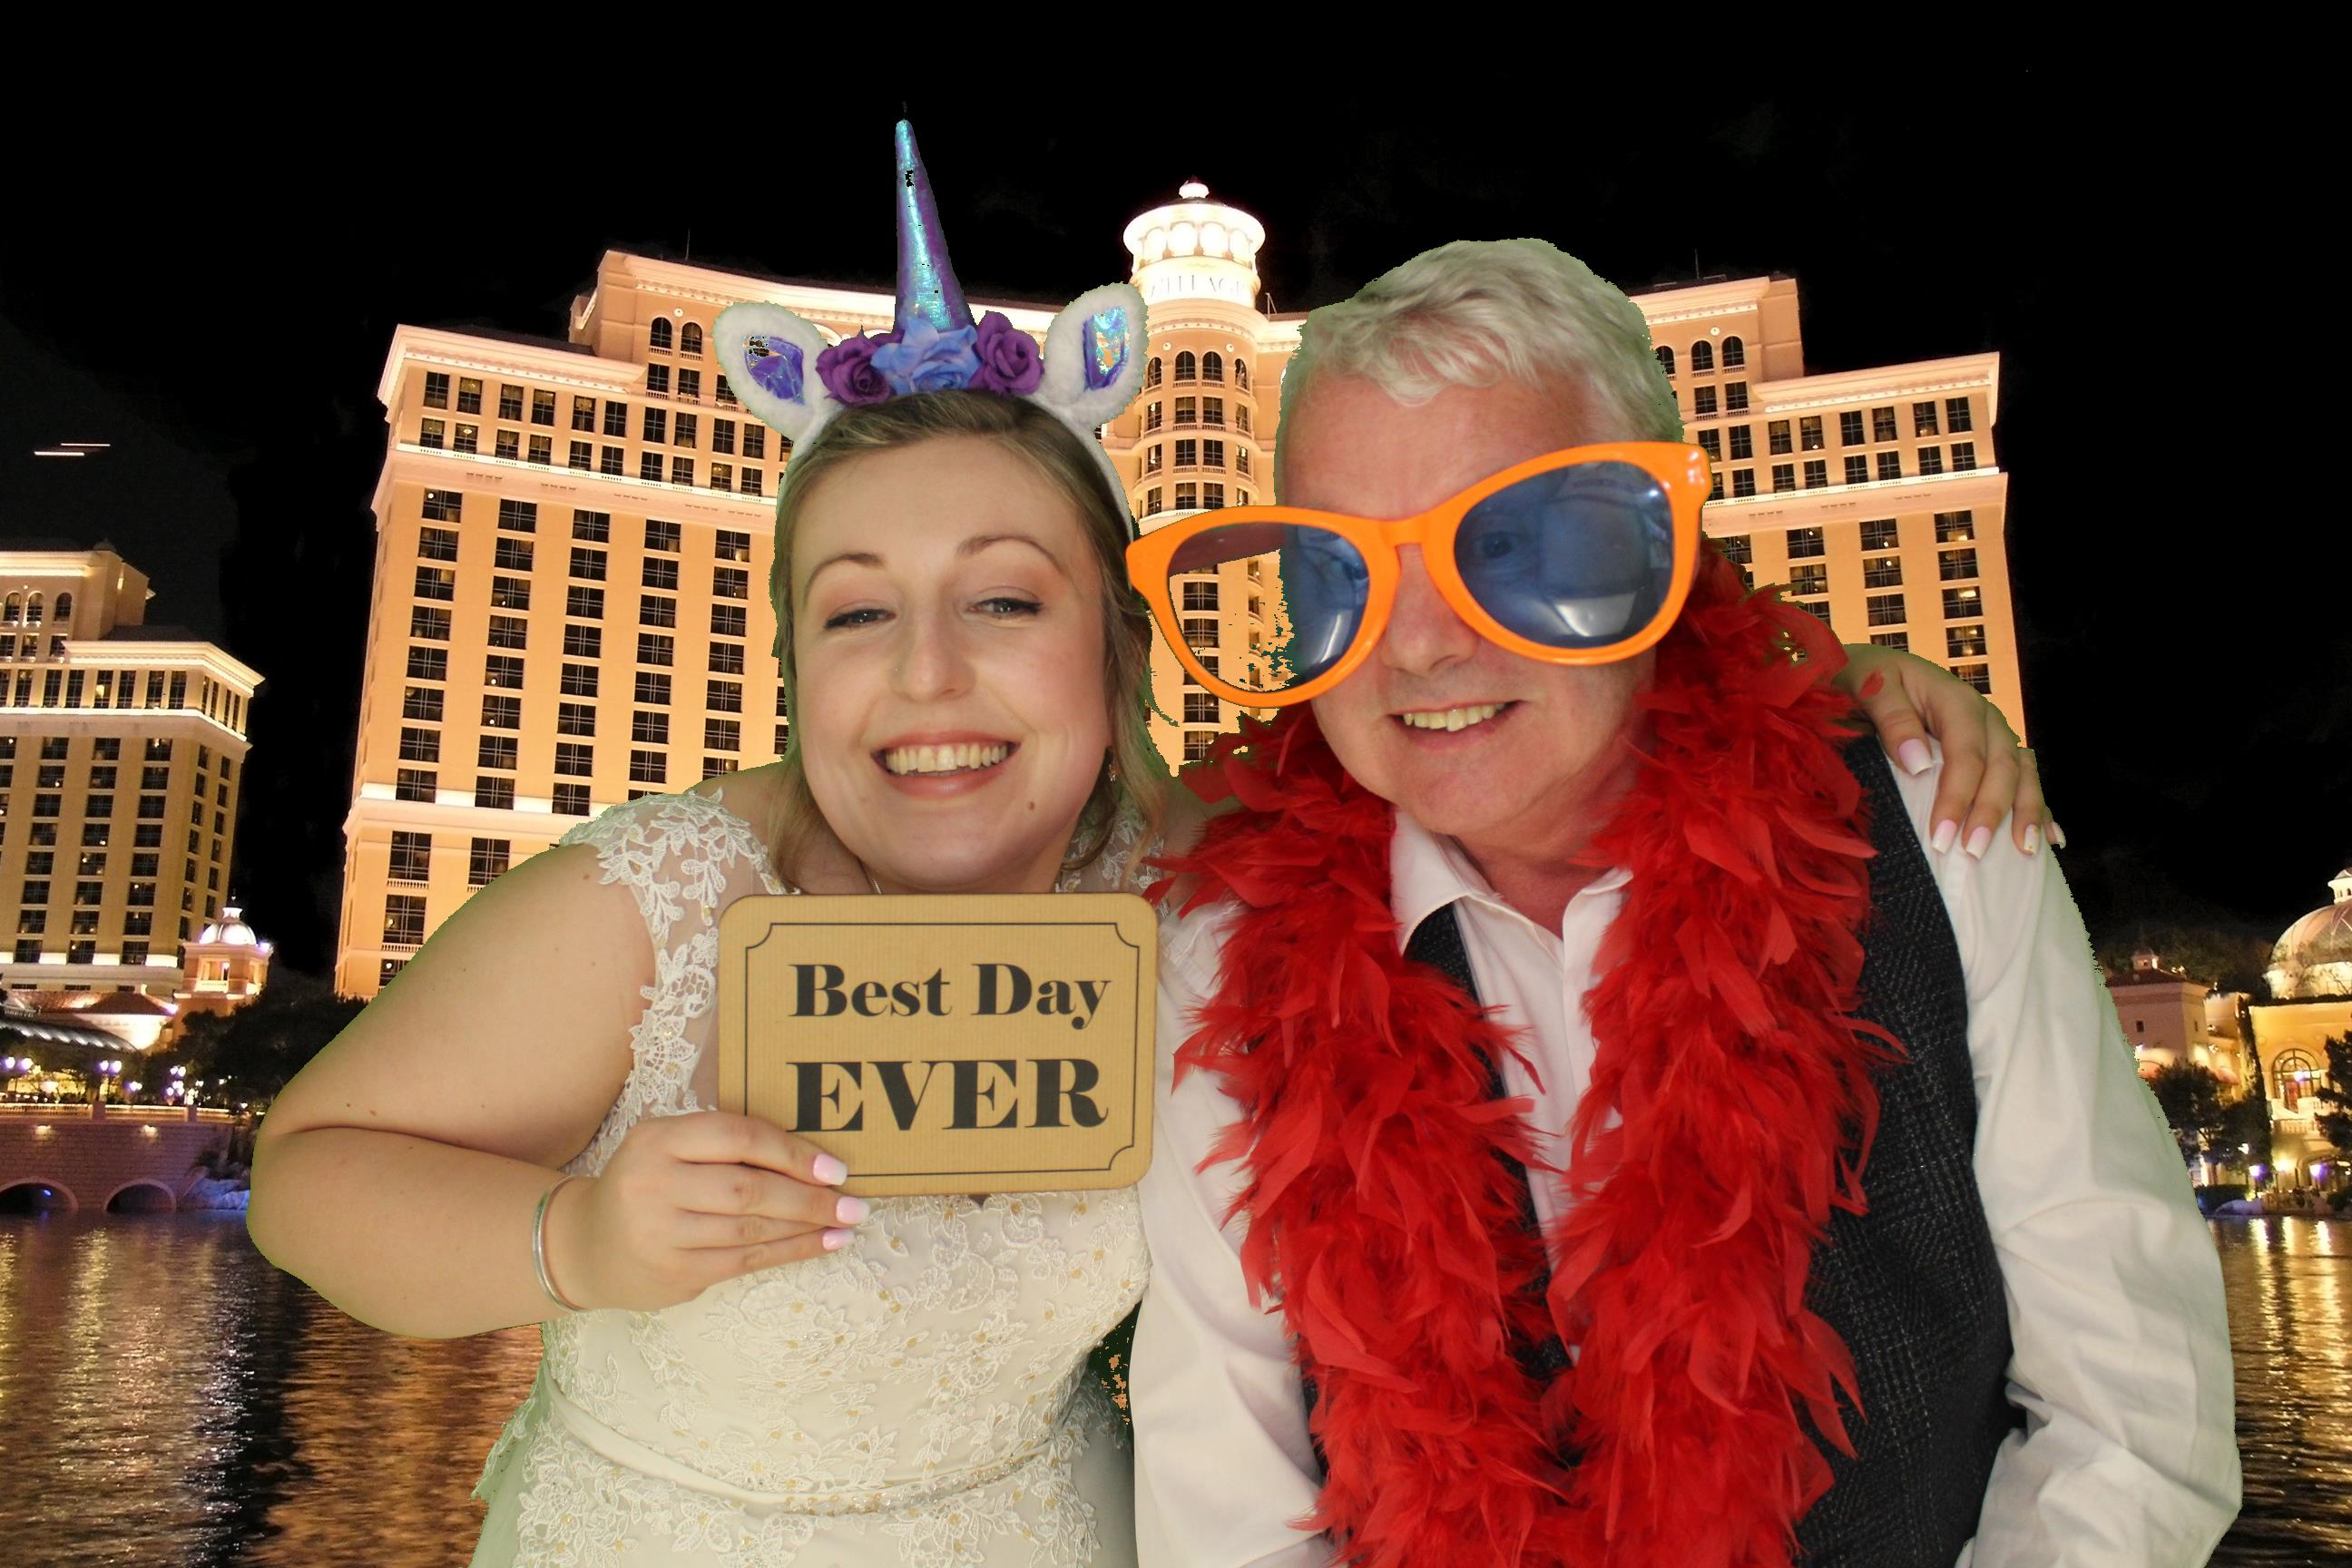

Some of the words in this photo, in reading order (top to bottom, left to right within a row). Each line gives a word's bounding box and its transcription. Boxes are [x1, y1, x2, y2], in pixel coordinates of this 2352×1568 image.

[788, 964, 953, 1017] Best
[971, 963, 1112, 1030] Day
[786, 1058, 1109, 1132] EVER
